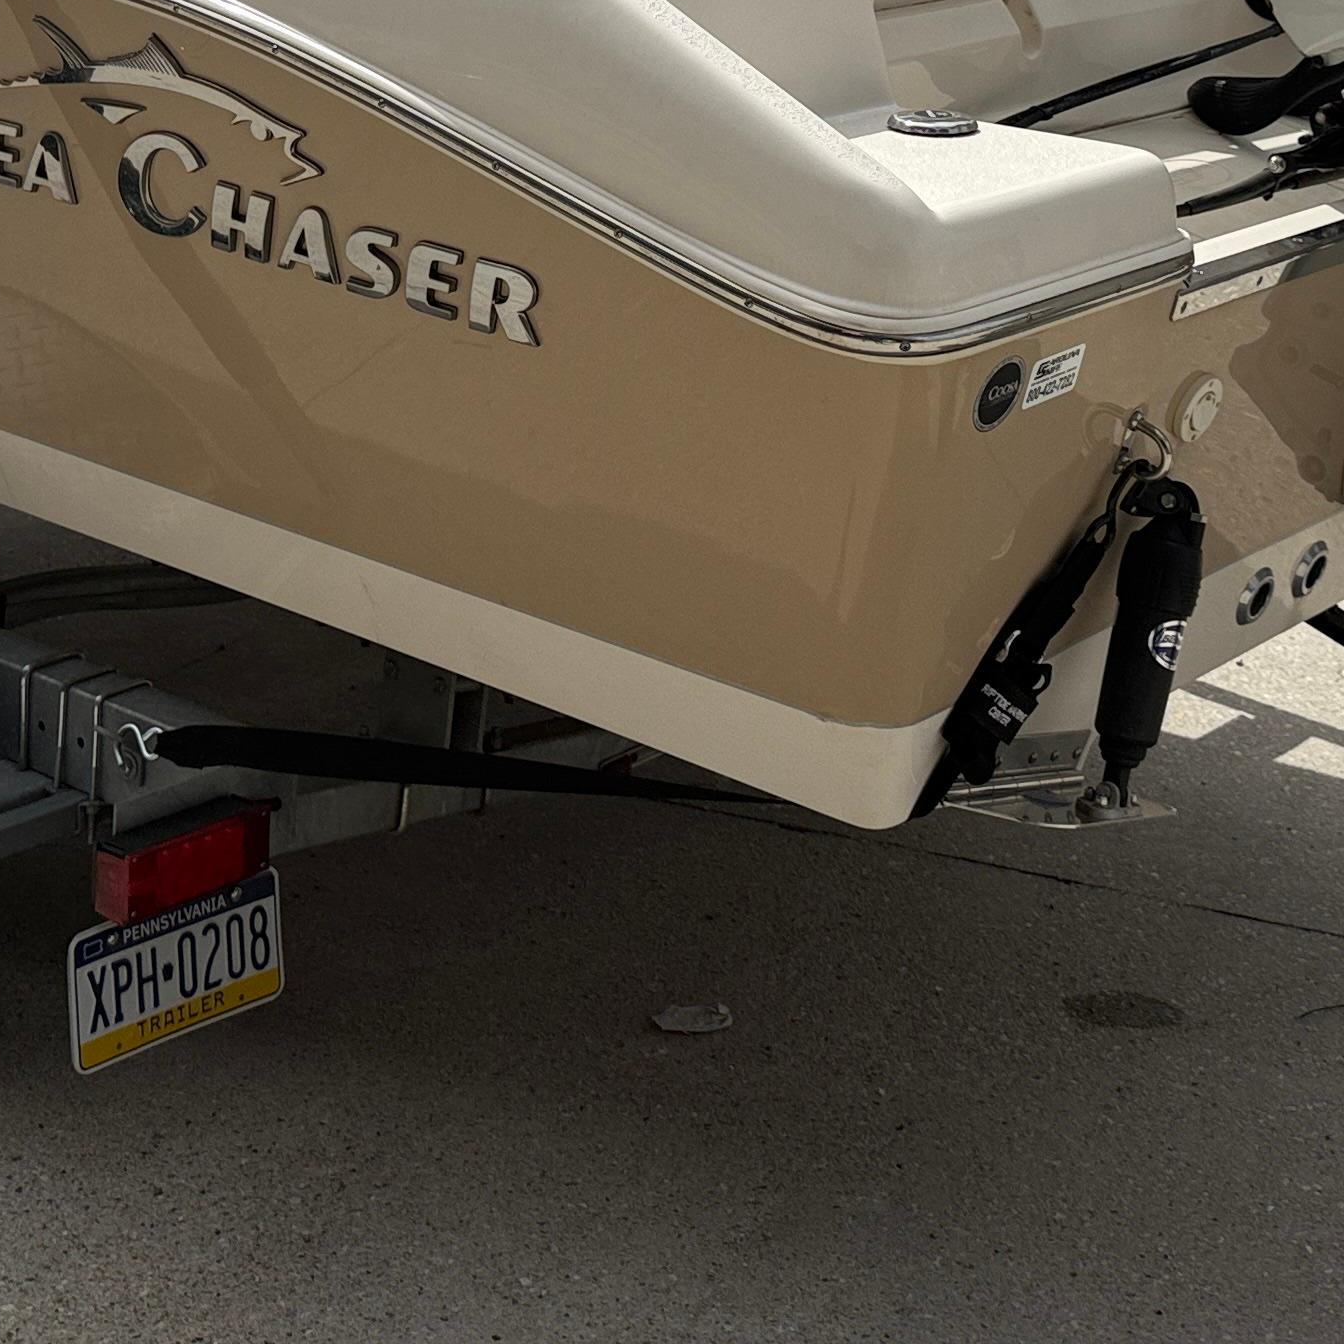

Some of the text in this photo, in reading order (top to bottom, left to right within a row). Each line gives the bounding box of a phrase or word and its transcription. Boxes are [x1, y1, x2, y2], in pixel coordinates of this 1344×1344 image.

[117, 129, 541, 347] CHASER
[122, 894, 227, 944] PENNSYLVANIA
[137, 991, 225, 1038] TRAILER
